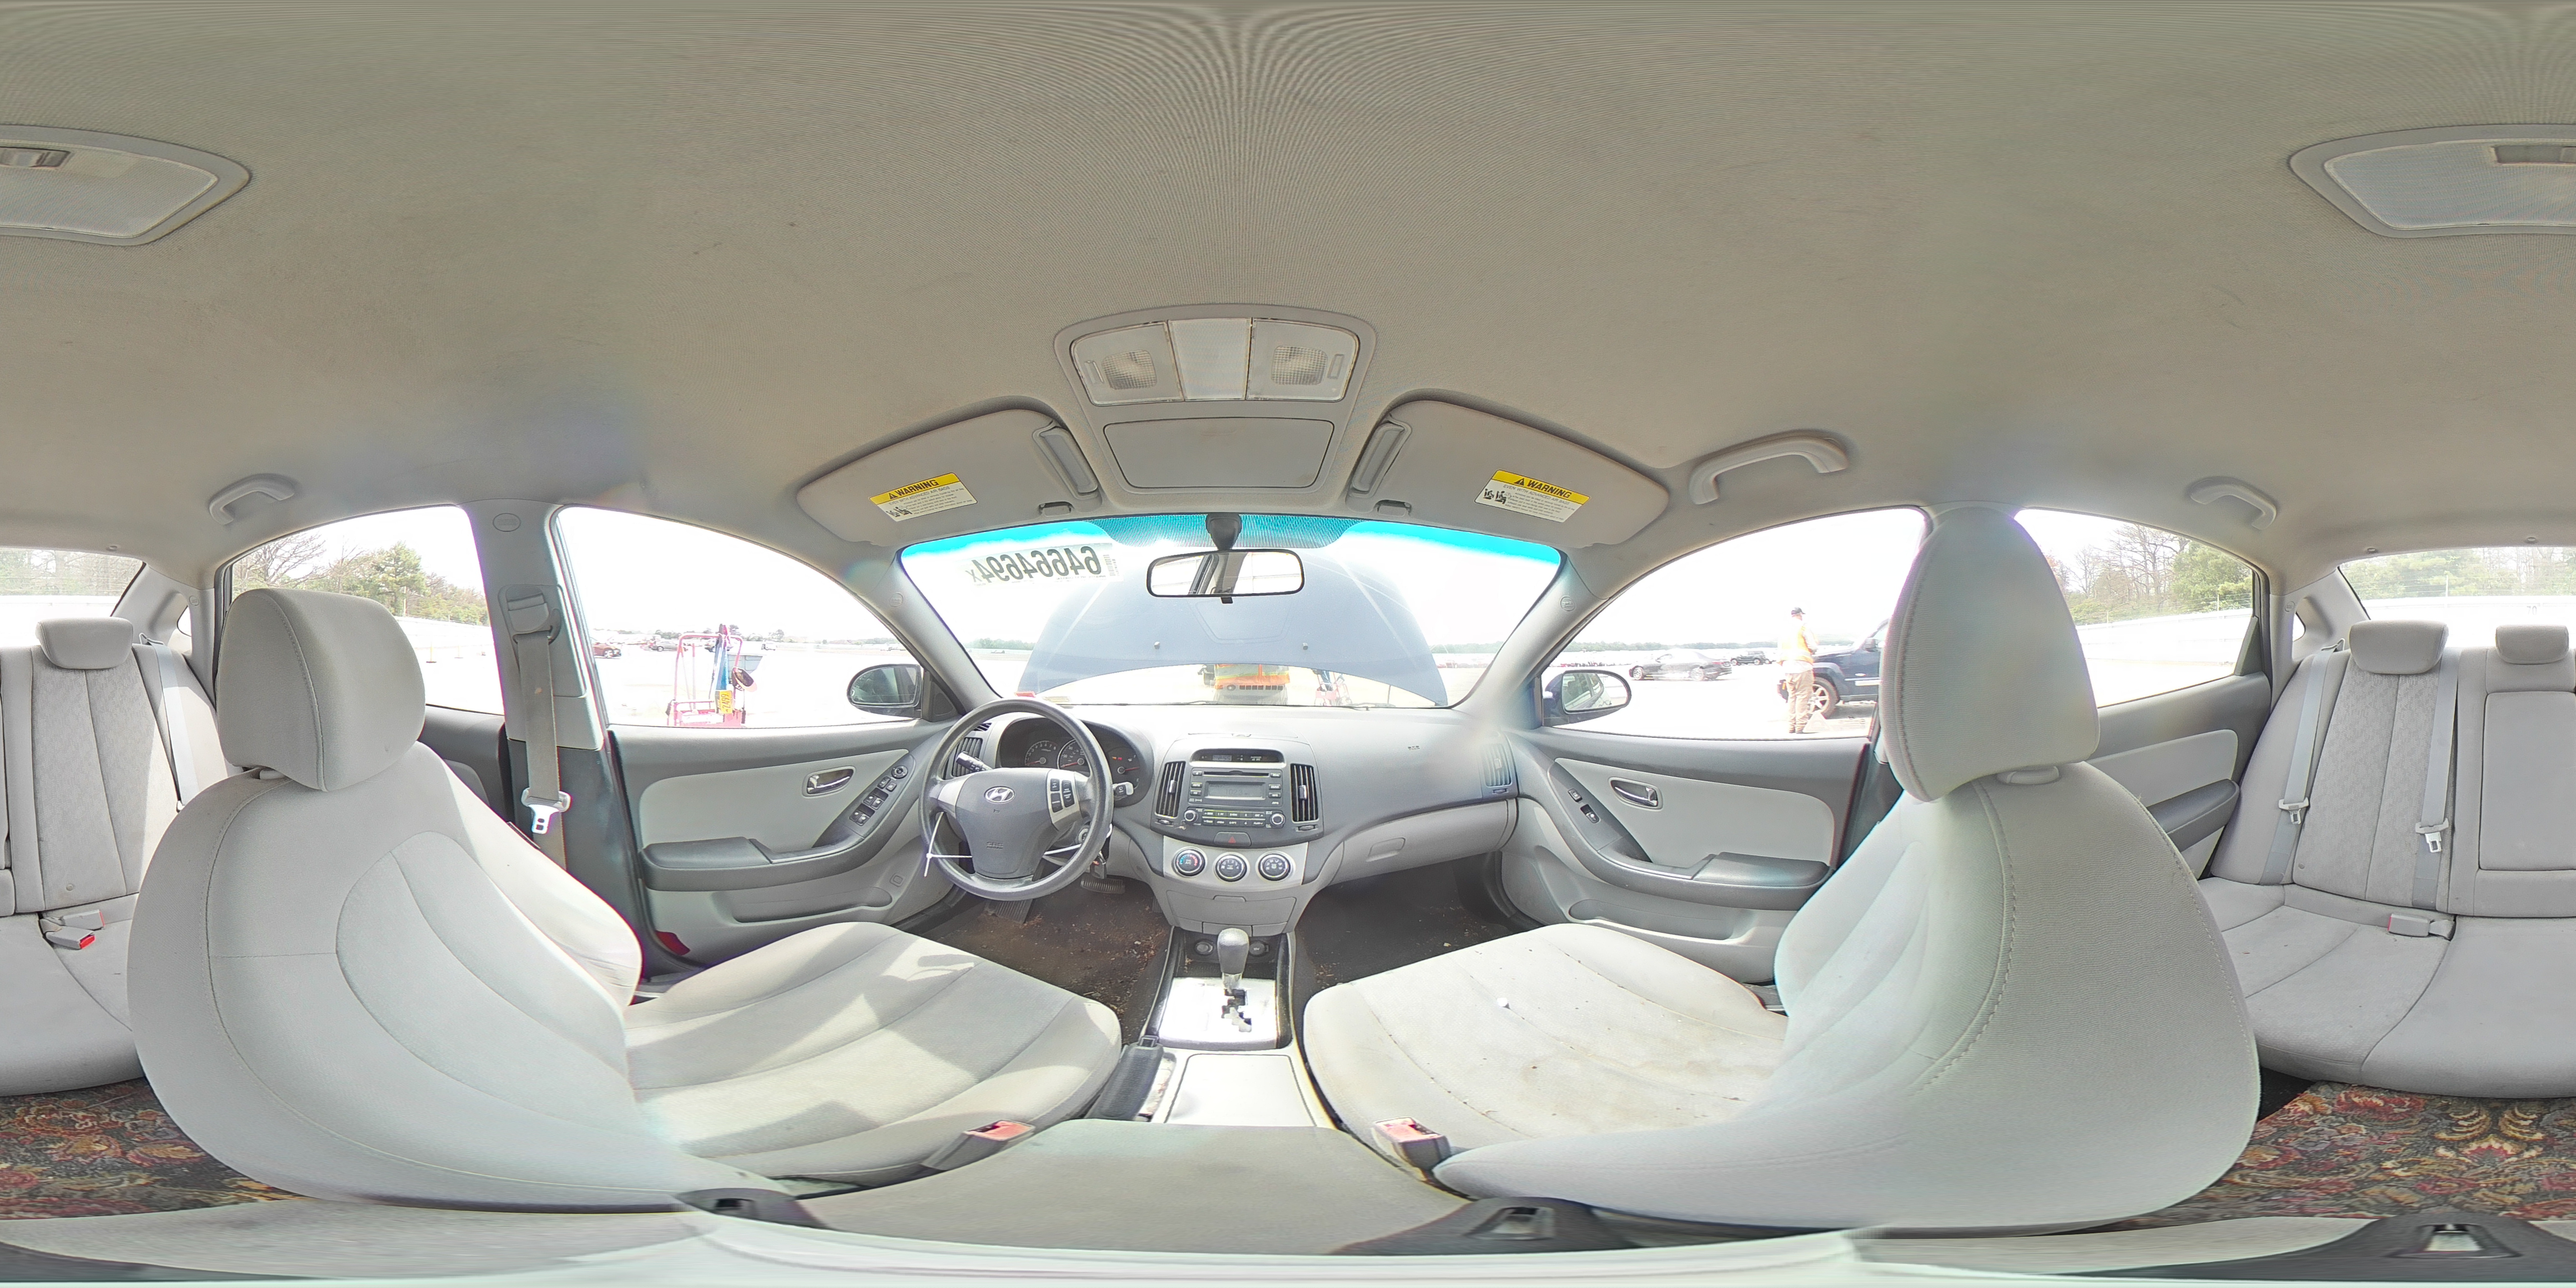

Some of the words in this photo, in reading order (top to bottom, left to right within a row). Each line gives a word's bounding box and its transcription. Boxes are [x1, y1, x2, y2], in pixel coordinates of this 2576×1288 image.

[895, 480, 939, 496] WARNING
[1528, 480, 1572, 498] WARNING
[1529, 491, 1551, 499] ADVANCED
[2527, 606, 2537, 615] 70
